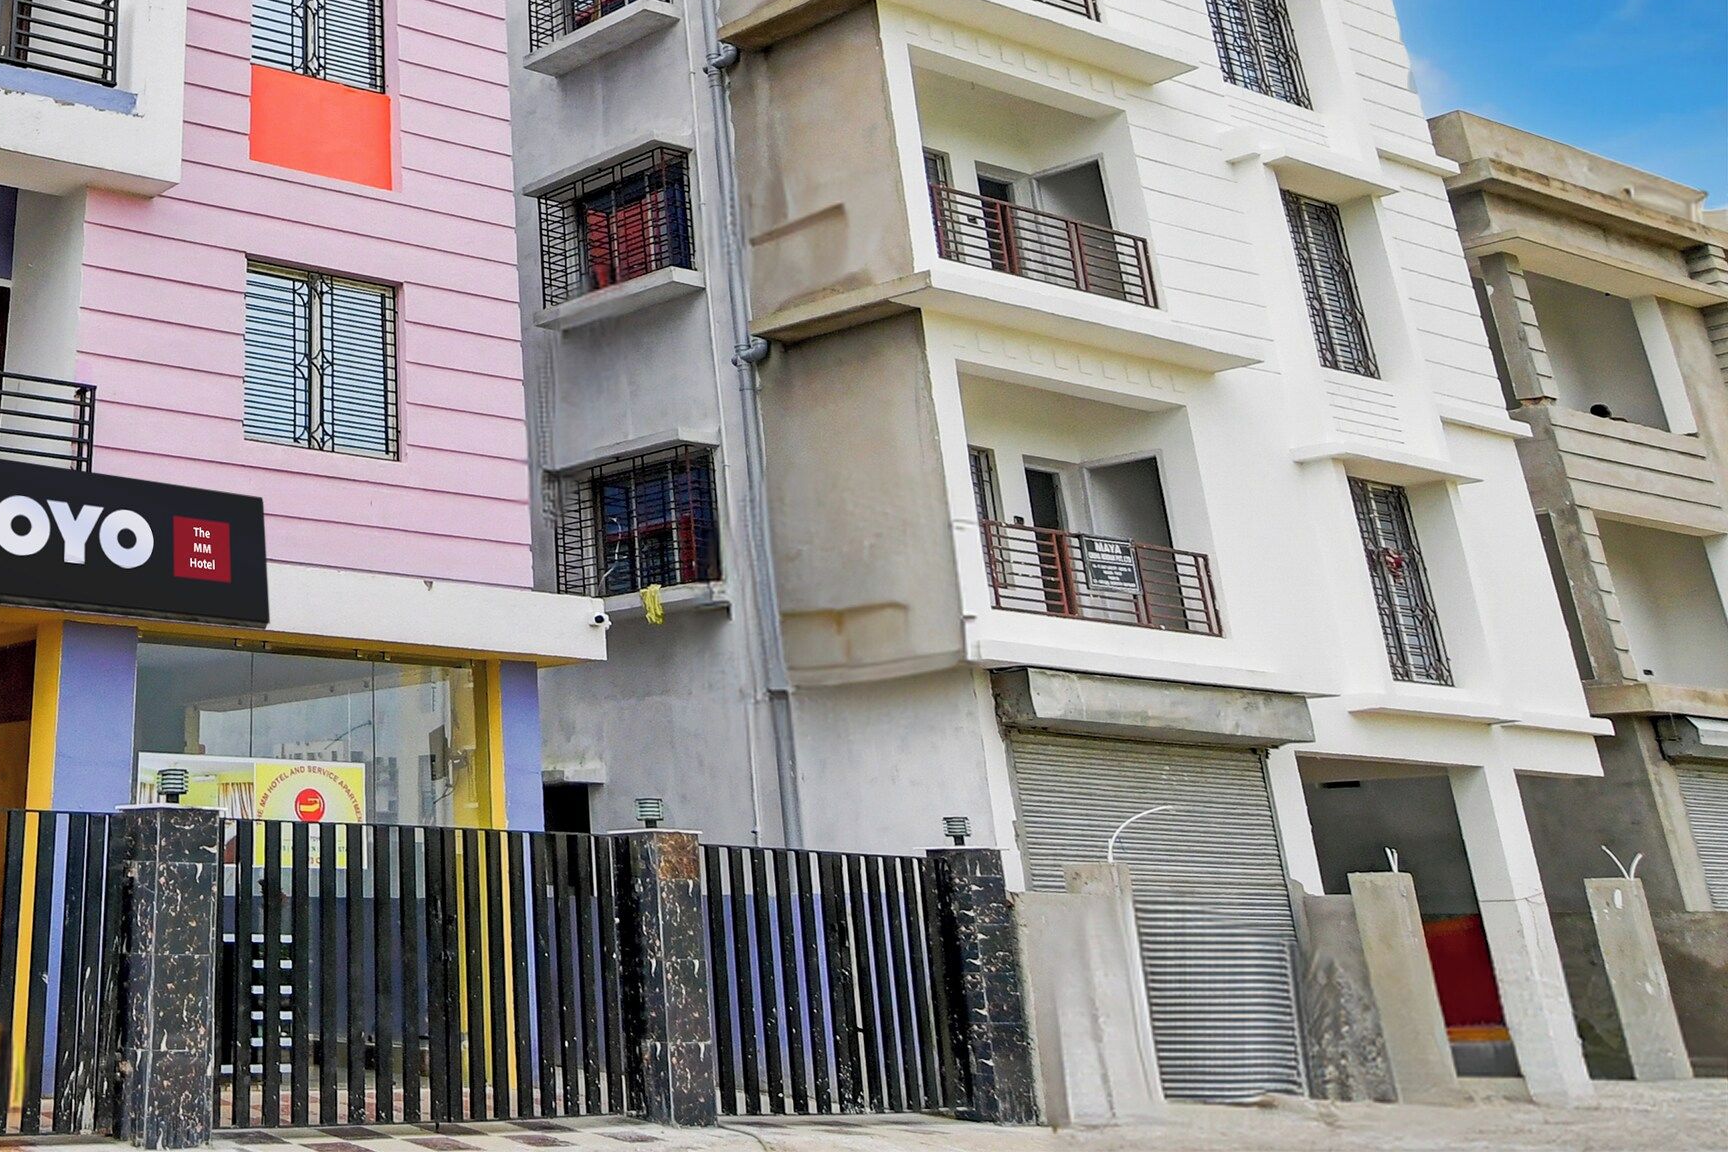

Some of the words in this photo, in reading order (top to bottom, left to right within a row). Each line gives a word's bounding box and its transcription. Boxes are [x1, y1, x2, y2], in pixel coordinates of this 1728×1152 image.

[193, 526, 211, 539] The
[193, 542, 212, 554] MM
[1093, 541, 1122, 555] MAYA
[189, 557, 216, 570] Hotel
[268, 772, 290, 794] HOTEL
[290, 765, 306, 777] AND
[307, 765, 340, 782] SERVICE
[337, 780, 363, 823] APARTMEN
